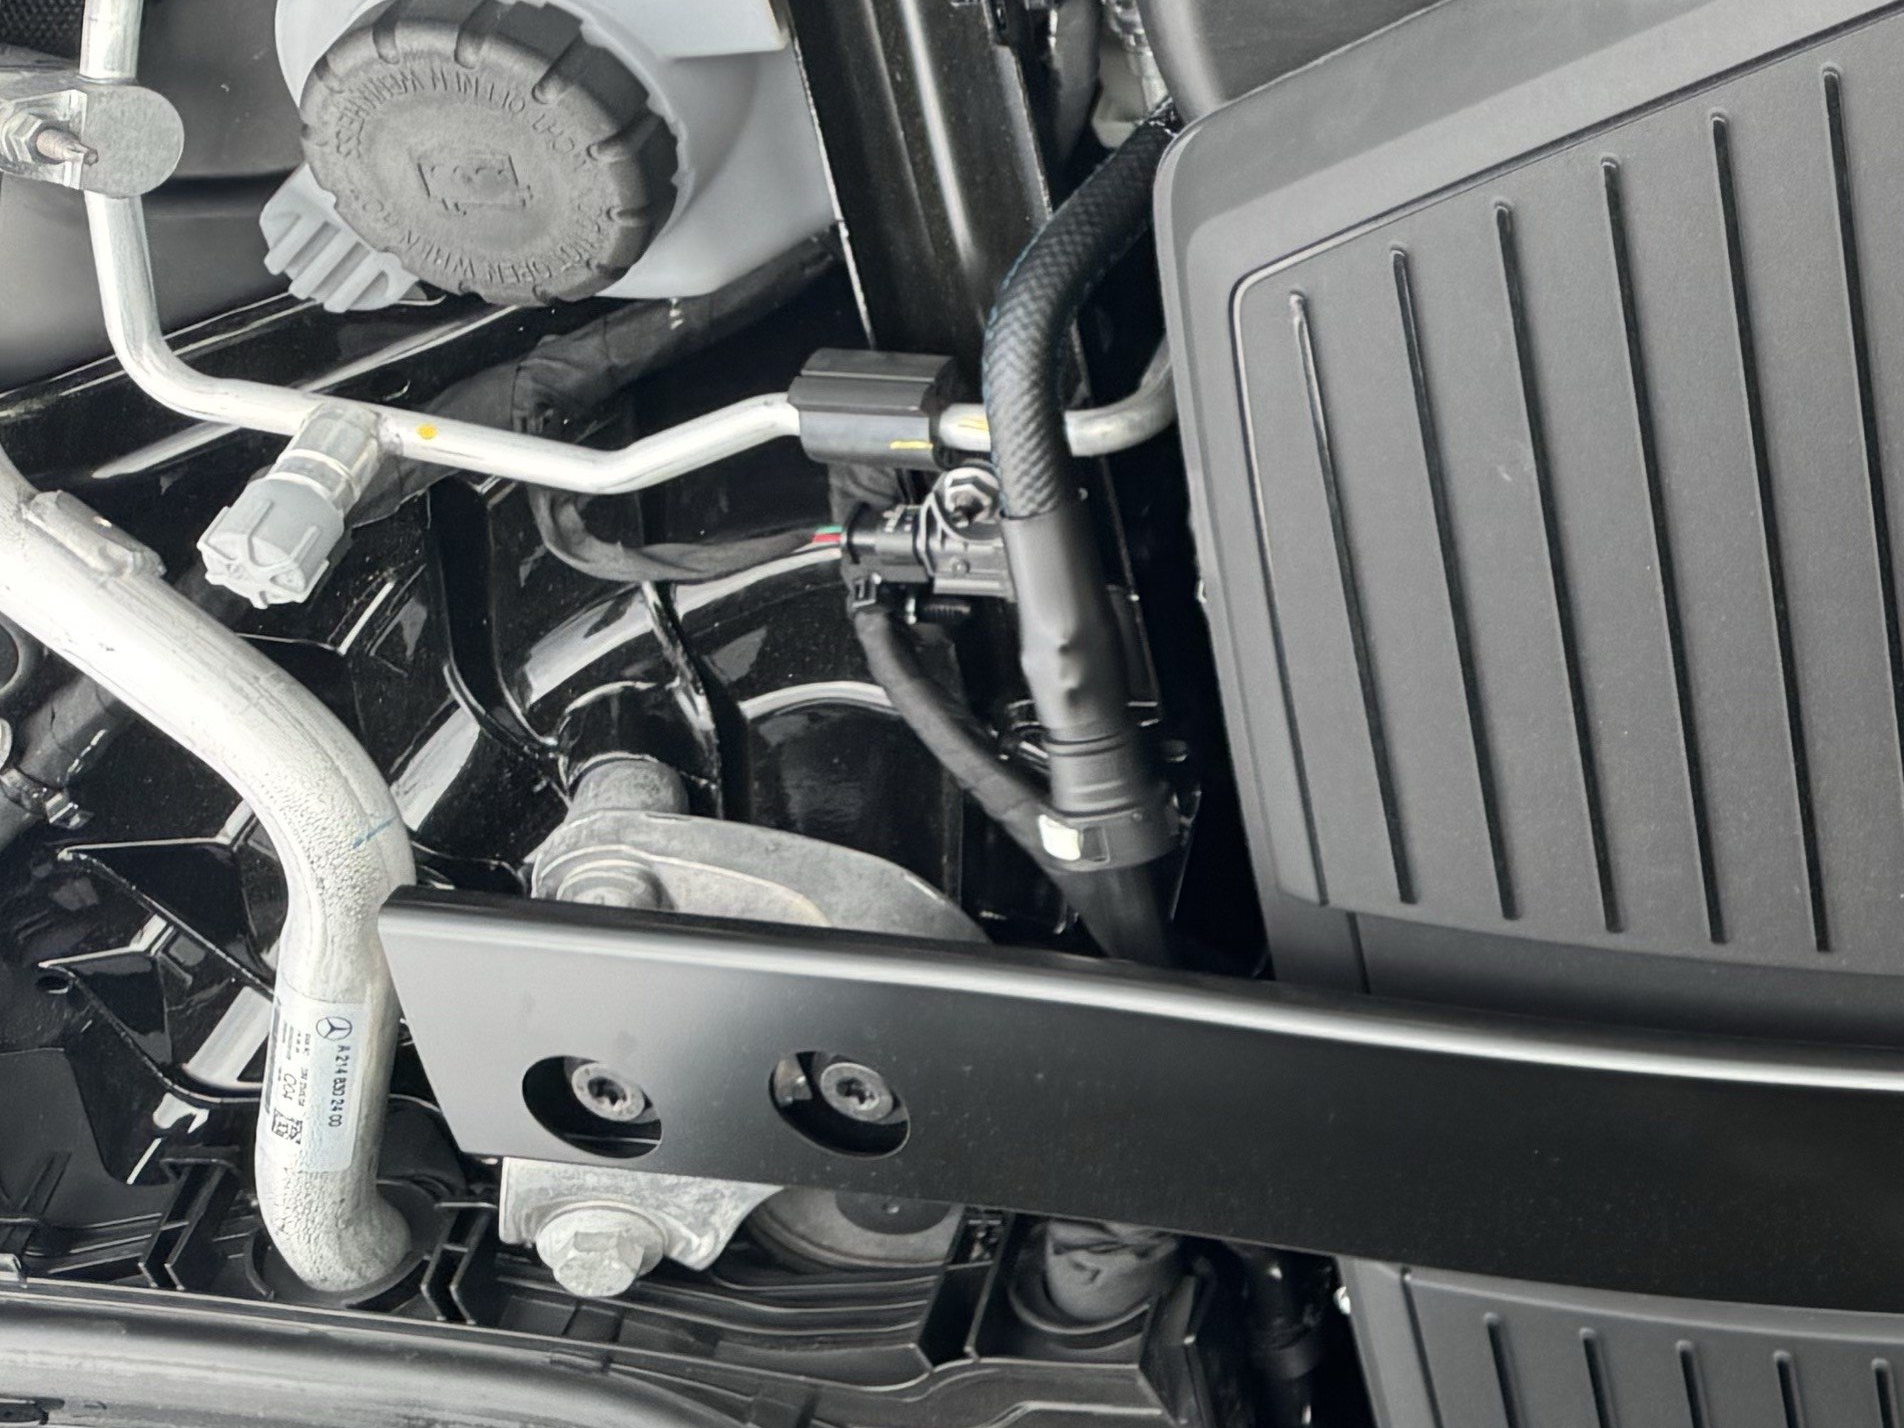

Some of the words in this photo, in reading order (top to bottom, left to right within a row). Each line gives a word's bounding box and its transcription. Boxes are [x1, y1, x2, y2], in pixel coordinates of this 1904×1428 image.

[337, 1043, 351, 1052] A
[333, 1054, 351, 1074] 214
[330, 1098, 344, 1112] 24
[327, 1114, 342, 1128] 00
